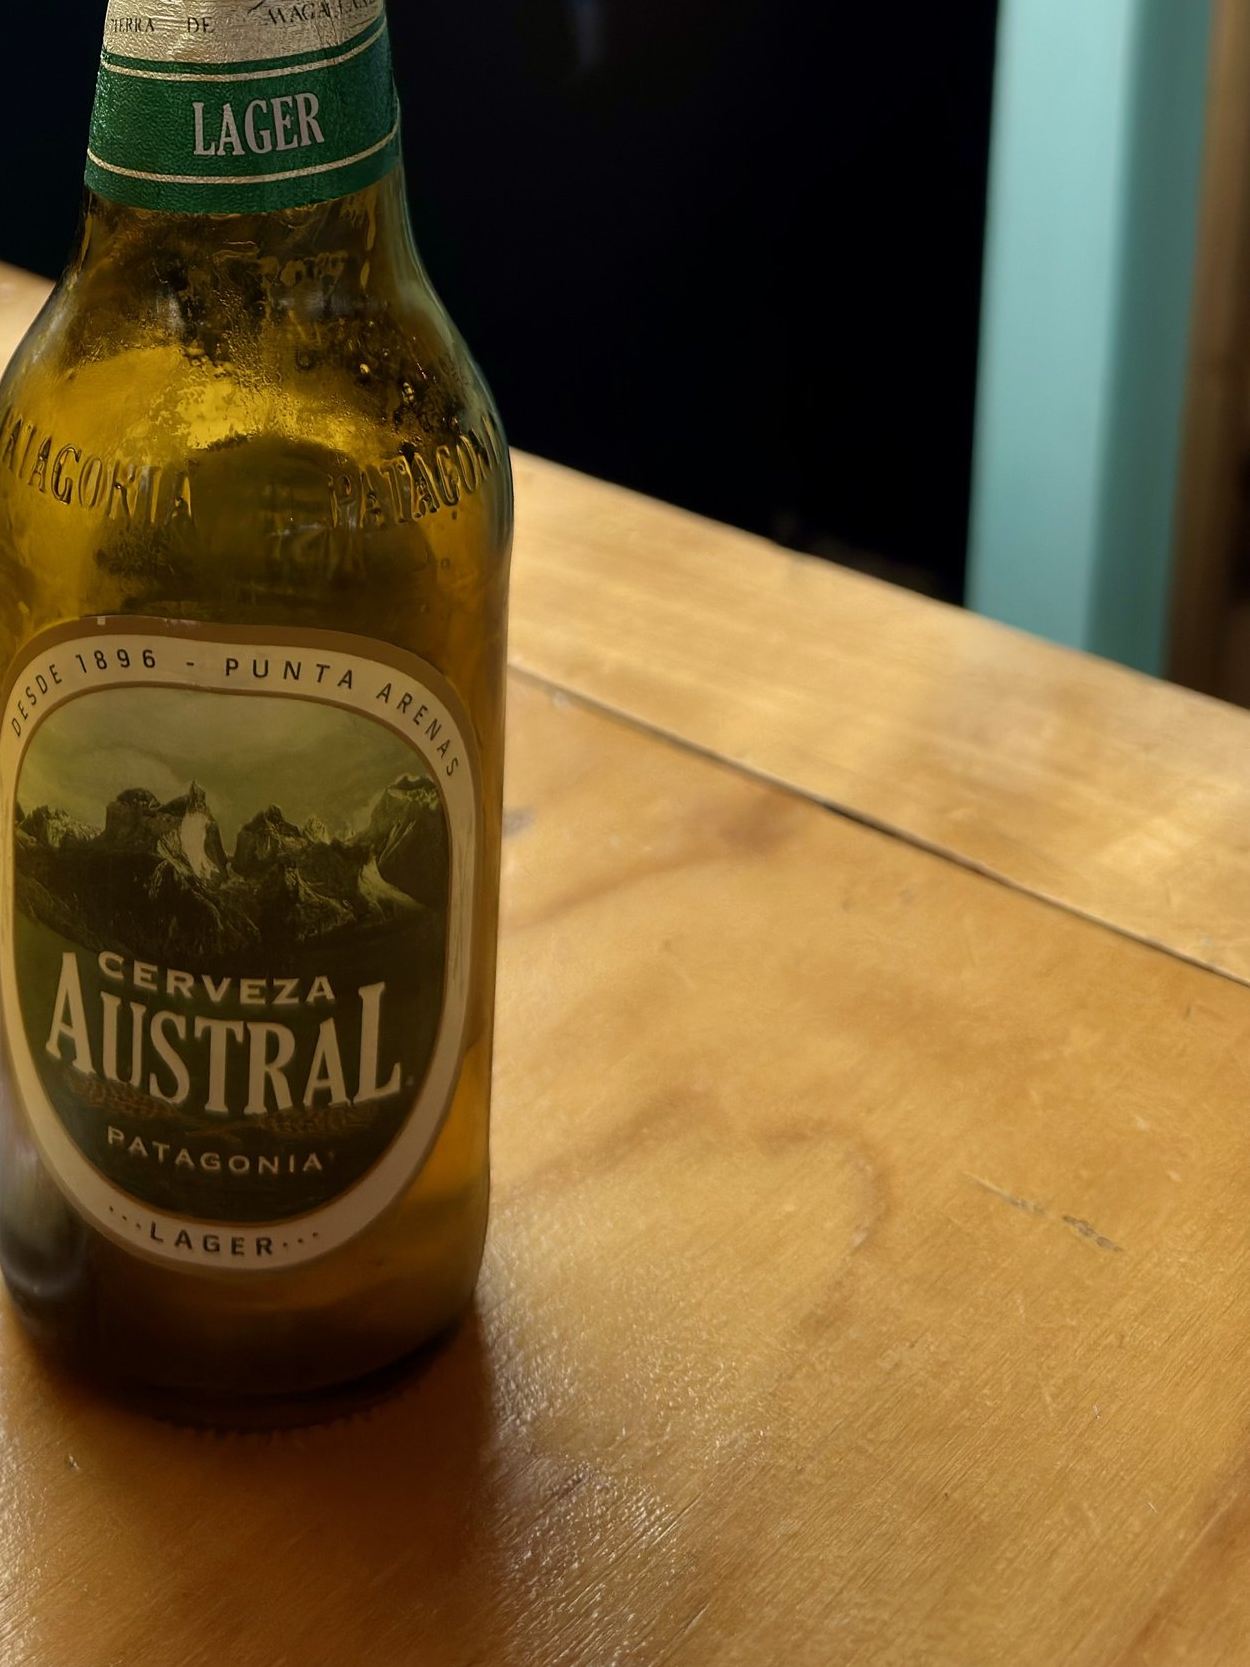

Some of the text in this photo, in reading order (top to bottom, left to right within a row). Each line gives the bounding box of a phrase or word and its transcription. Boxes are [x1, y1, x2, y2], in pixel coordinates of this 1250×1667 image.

[187, 16, 215, 34] DE
[192, 91, 325, 157] LAGER
[11, 663, 63, 738] DESDE
[75, 648, 157, 674] 1896
[225, 656, 354, 690] PUNTA
[375, 682, 460, 779] ARENAS
[97, 949, 337, 1006] CERVEZA
[45, 951, 402, 1115] AUSTRAL
[107, 1125, 324, 1175] PATAGONIA
[149, 1221, 272, 1256] LAGER
